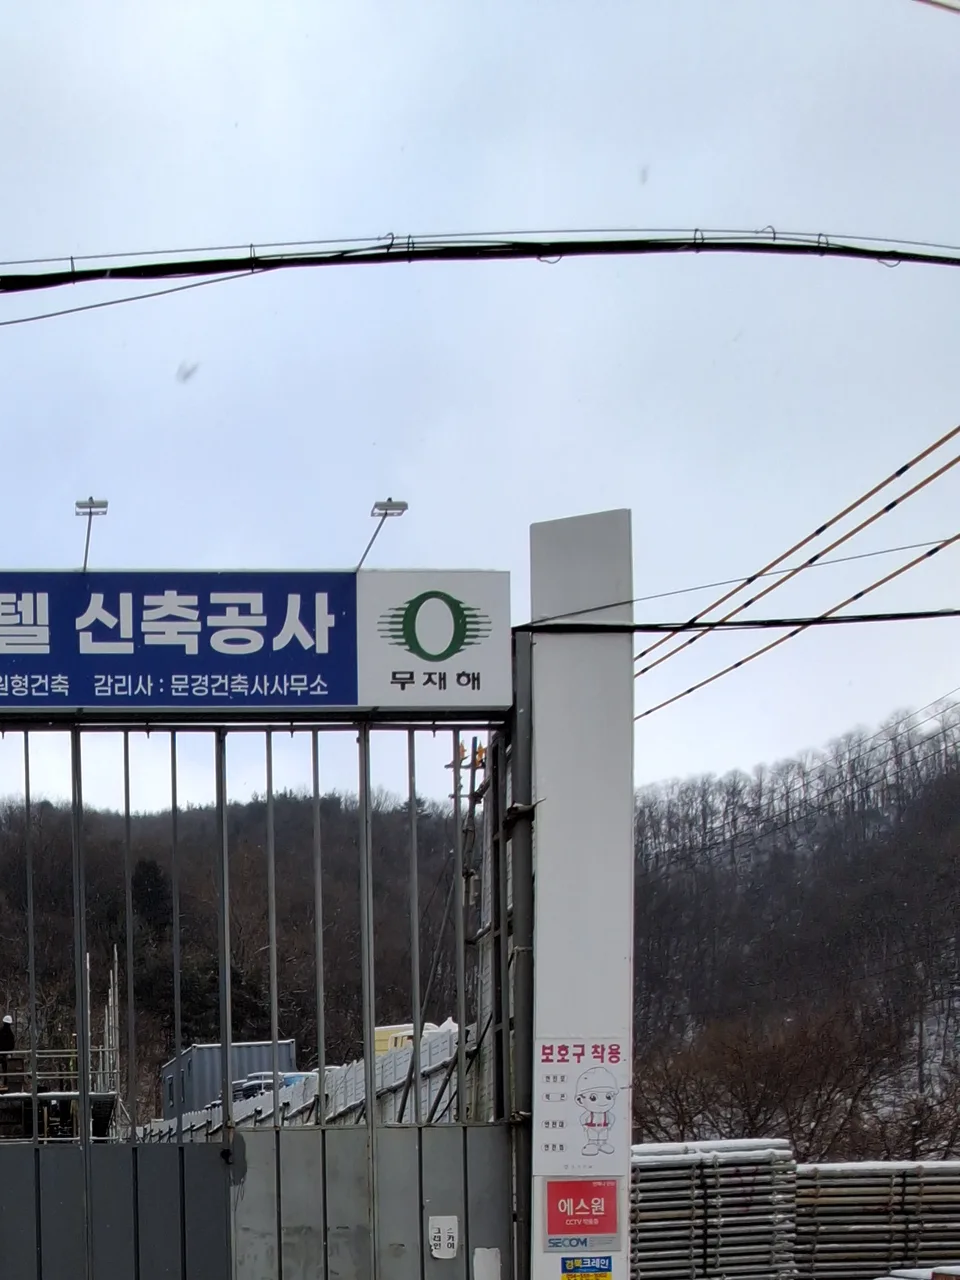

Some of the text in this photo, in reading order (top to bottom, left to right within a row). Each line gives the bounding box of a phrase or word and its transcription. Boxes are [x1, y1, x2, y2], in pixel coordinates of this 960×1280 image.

[75, 590, 336, 656] 신축공사
[94, 673, 153, 697] 감리사
[171, 673, 329, 697] 문경건축사사무소
[389, 669, 482, 692] 무재해
[541, 1043, 621, 1064] 보호구 착용
[558, 1197, 605, 1216] 에스원
[548, 1237, 588, 1248] SECOM
